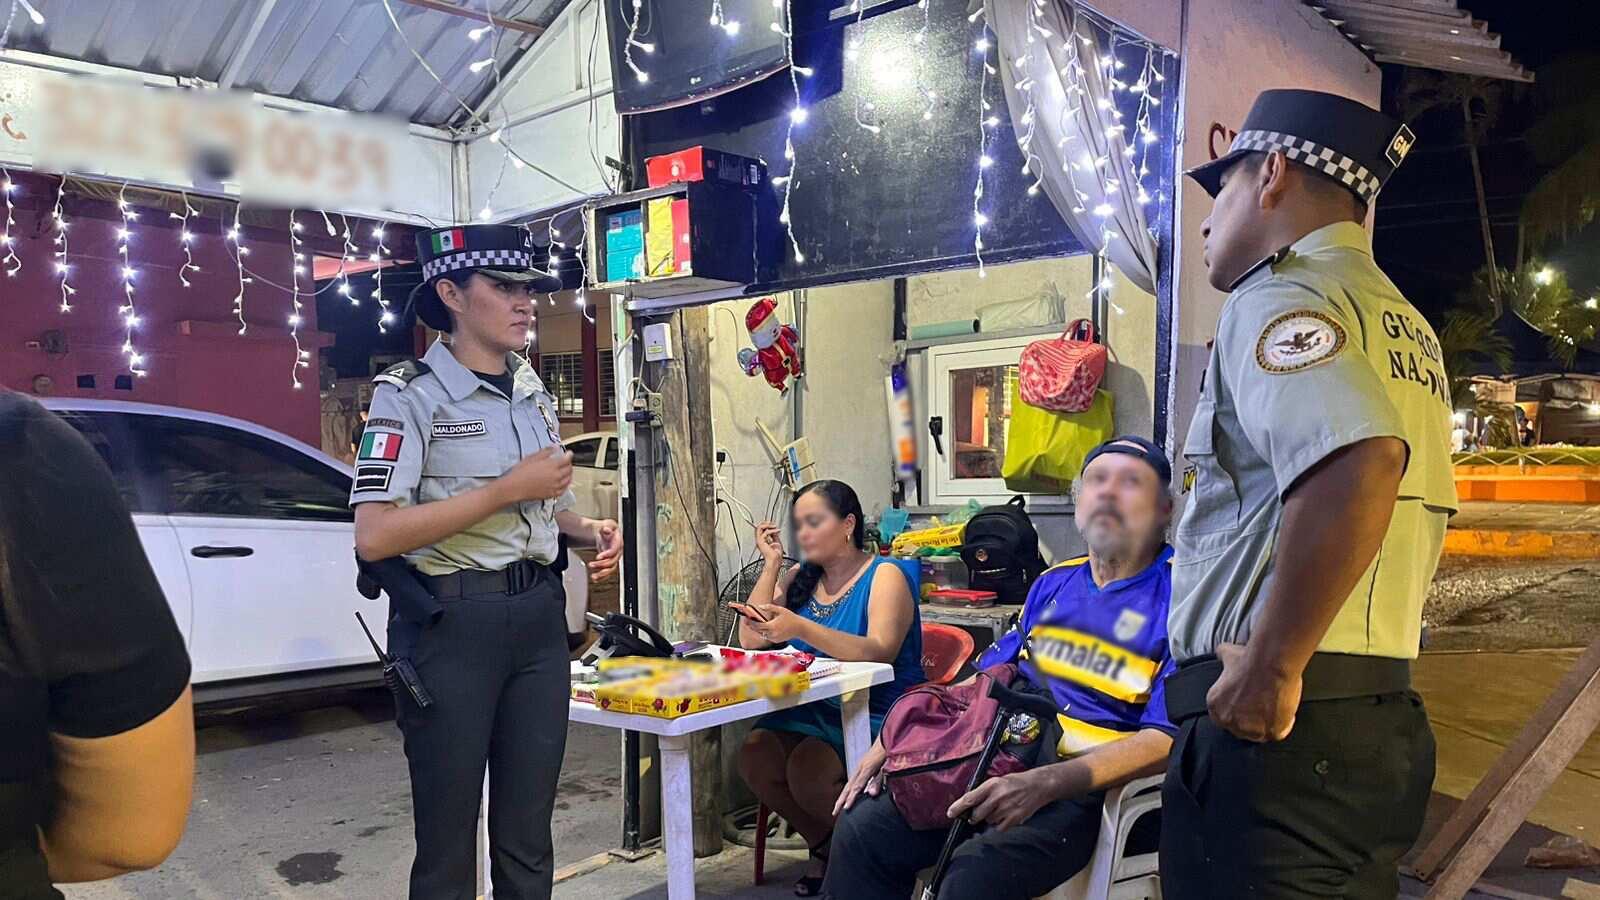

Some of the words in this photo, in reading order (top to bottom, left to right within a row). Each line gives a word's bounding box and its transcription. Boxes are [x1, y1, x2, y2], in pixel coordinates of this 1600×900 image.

[1393, 135, 1410, 158] GN
[433, 422, 483, 434] MALDONADO
[1034, 635, 1127, 681] rmalat
